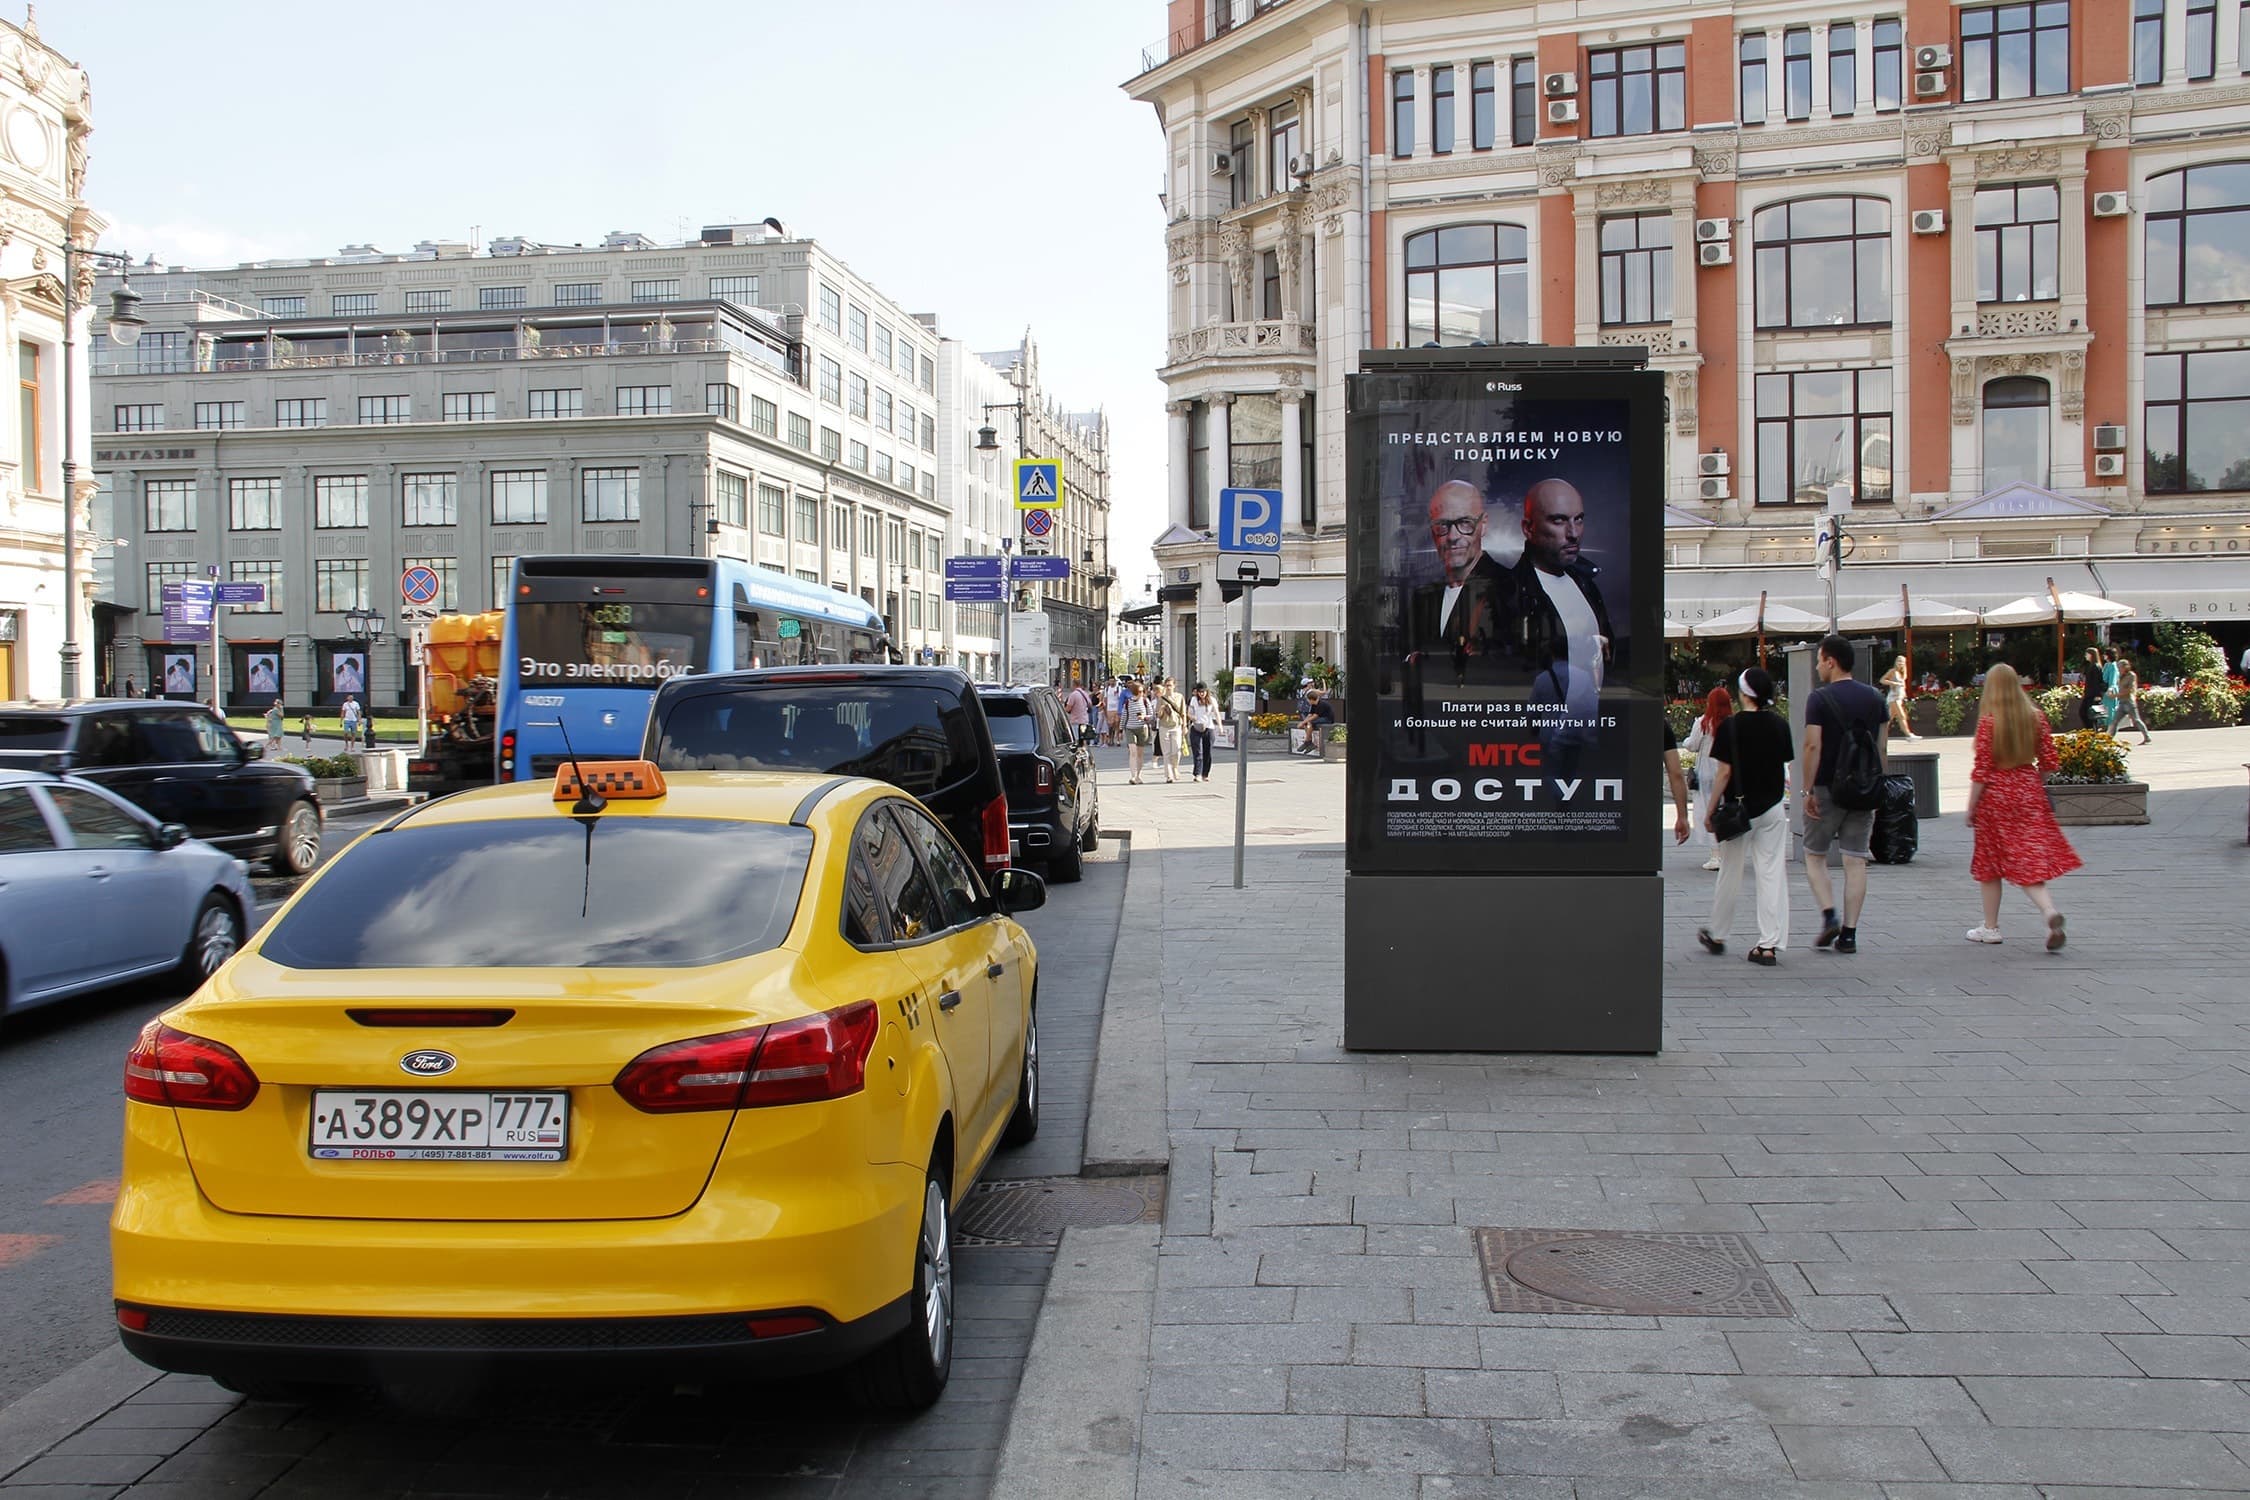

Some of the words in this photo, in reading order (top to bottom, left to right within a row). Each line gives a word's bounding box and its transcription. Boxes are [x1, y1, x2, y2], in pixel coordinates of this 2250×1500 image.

[1497, 382, 1522, 391] Russ
[1388, 431, 1544, 446] ПРЕДСТАВЛЯЕМ
[1554, 431, 1623, 443] НОВУЮ
[96, 449, 196, 461] МАГАЗИН
[1454, 448, 1560, 462] ПОДПИСКУ
[1232, 493, 1270, 546] P
[1265, 535, 1277, 544] 20
[1760, 549, 1890, 561] РЕСТАН
[520, 657, 562, 676] Это
[566, 659, 694, 682] электробус
[1442, 701, 1483, 713] Плати
[1486, 703, 1511, 715] раз
[1514, 704, 1522, 712] в
[1526, 703, 1568, 714] месяц
[1394, 719, 1402, 727] и
[1406, 716, 1457, 728] больше
[1461, 719, 1477, 728] не
[1481, 716, 1528, 728] считай
[1532, 719, 1584, 730] минуты
[1588, 719, 1596, 727] и
[1600, 717, 1616, 727] ГБ
[1468, 743, 1541, 766] МТС
[1387, 778, 1623, 801] ДОСТУП
[412, 1055, 444, 1070] Ford
[326, 1098, 482, 1140] А389ХР
[493, 1097, 553, 1129] 777
[506, 1130, 536, 1142] RUS
[352, 1149, 396, 1159] РОЛЬФ
[421, 1149, 445, 1160] (495)
[447, 1150, 492, 1159] 7-881-881
[503, 1151, 554, 1161] www.rolf.ru
